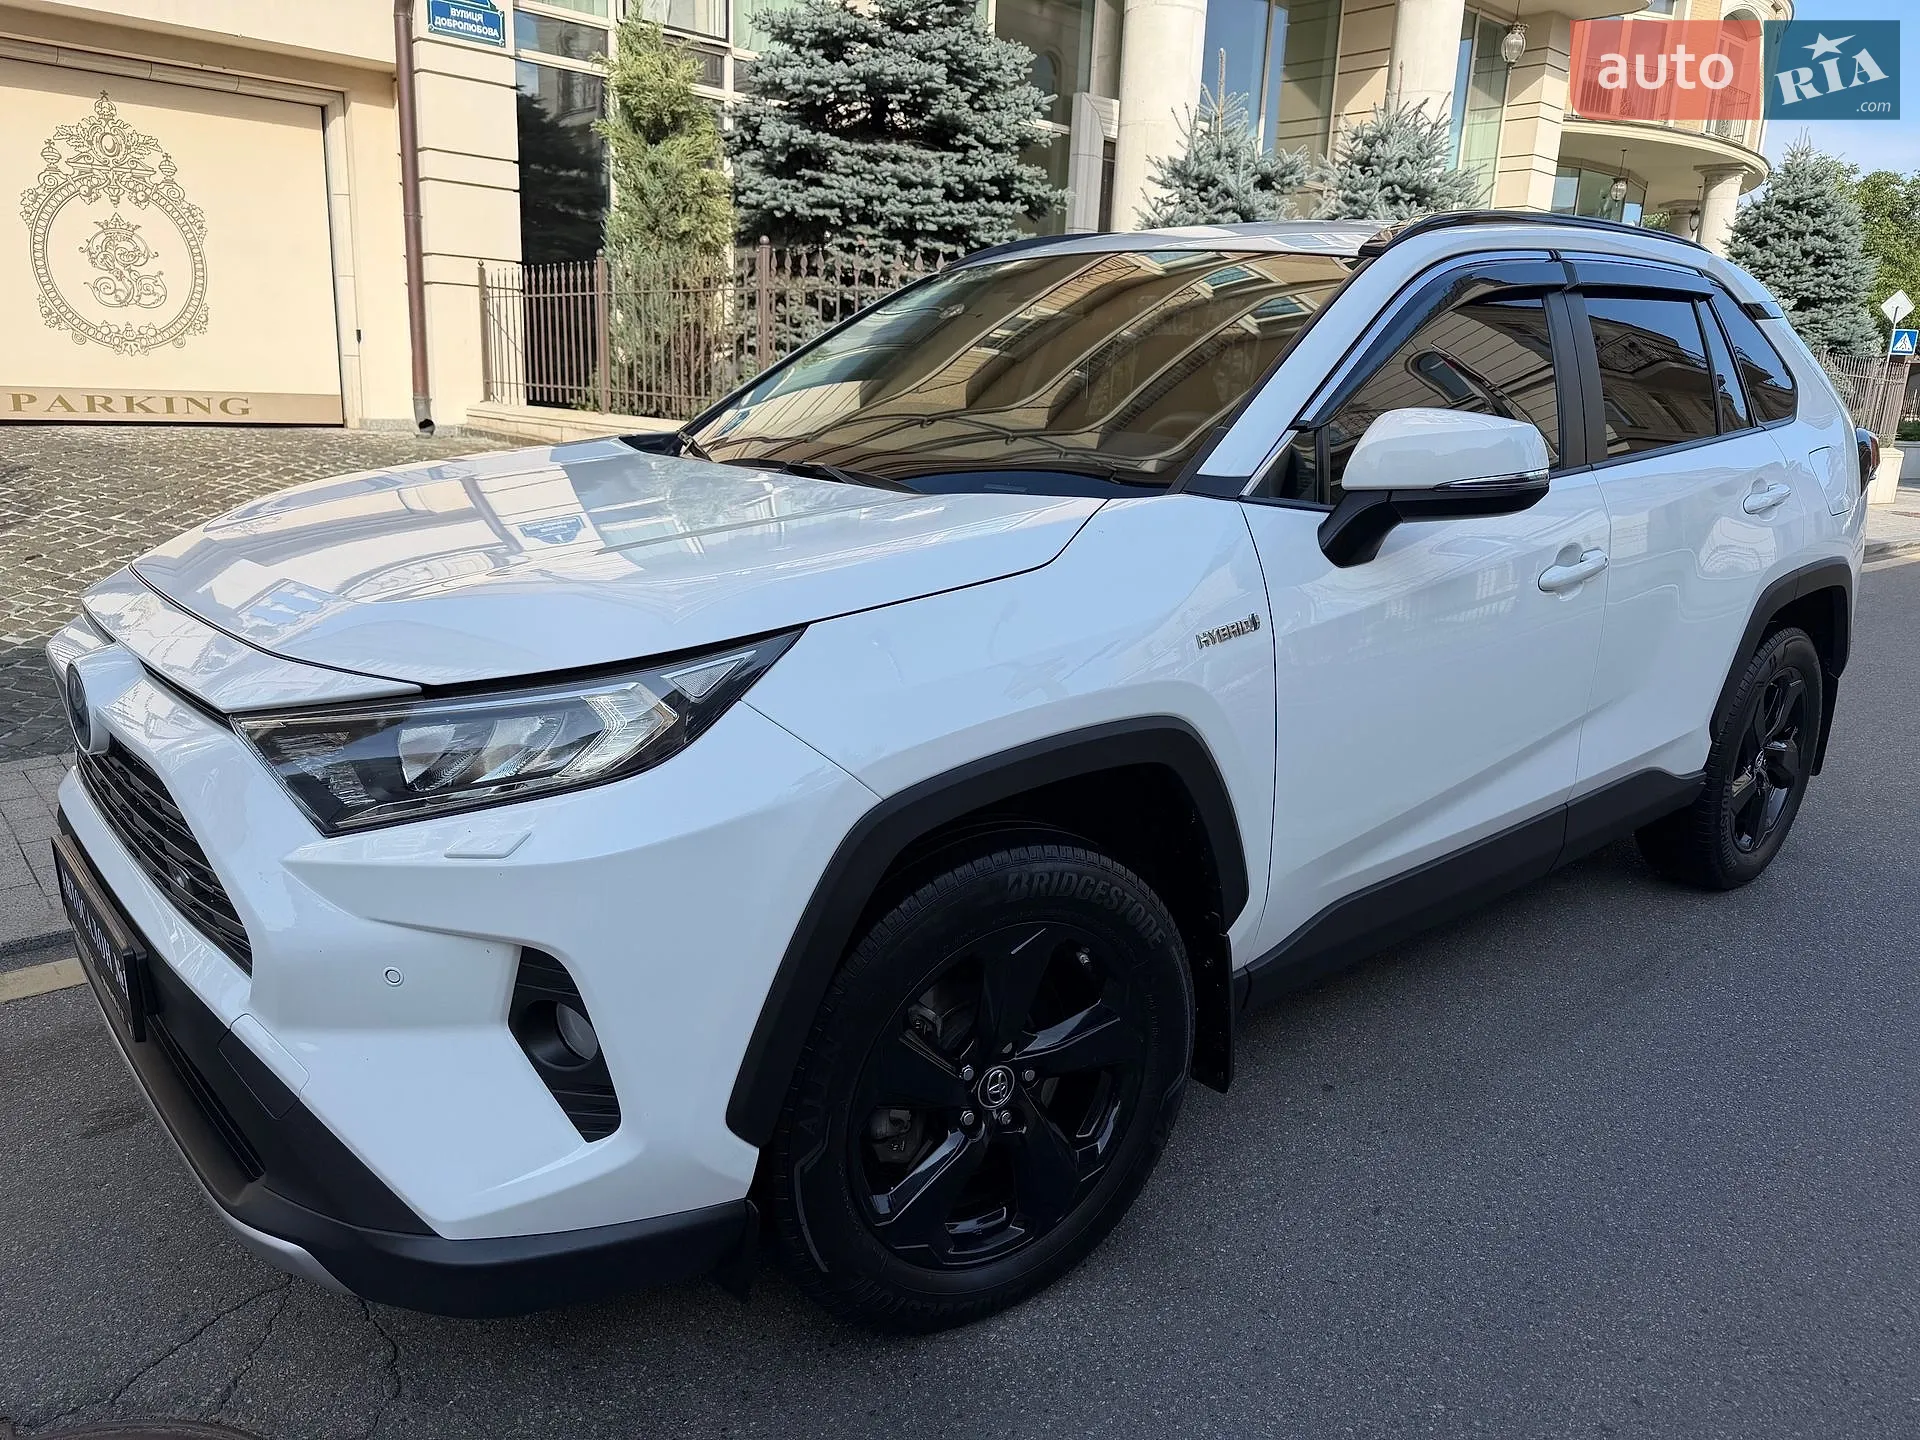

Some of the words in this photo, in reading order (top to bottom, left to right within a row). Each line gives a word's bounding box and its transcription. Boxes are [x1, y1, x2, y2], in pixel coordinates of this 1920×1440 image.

[450, 7, 484, 23] ВУЛИЦЯ
[434, 16, 499, 37] ДОБРОЛЮБОВА
[6, 393, 252, 415] PARKING
[1195, 619, 1253, 649] HYBRID
[1006, 871, 1166, 944] BRIDGESTONE
